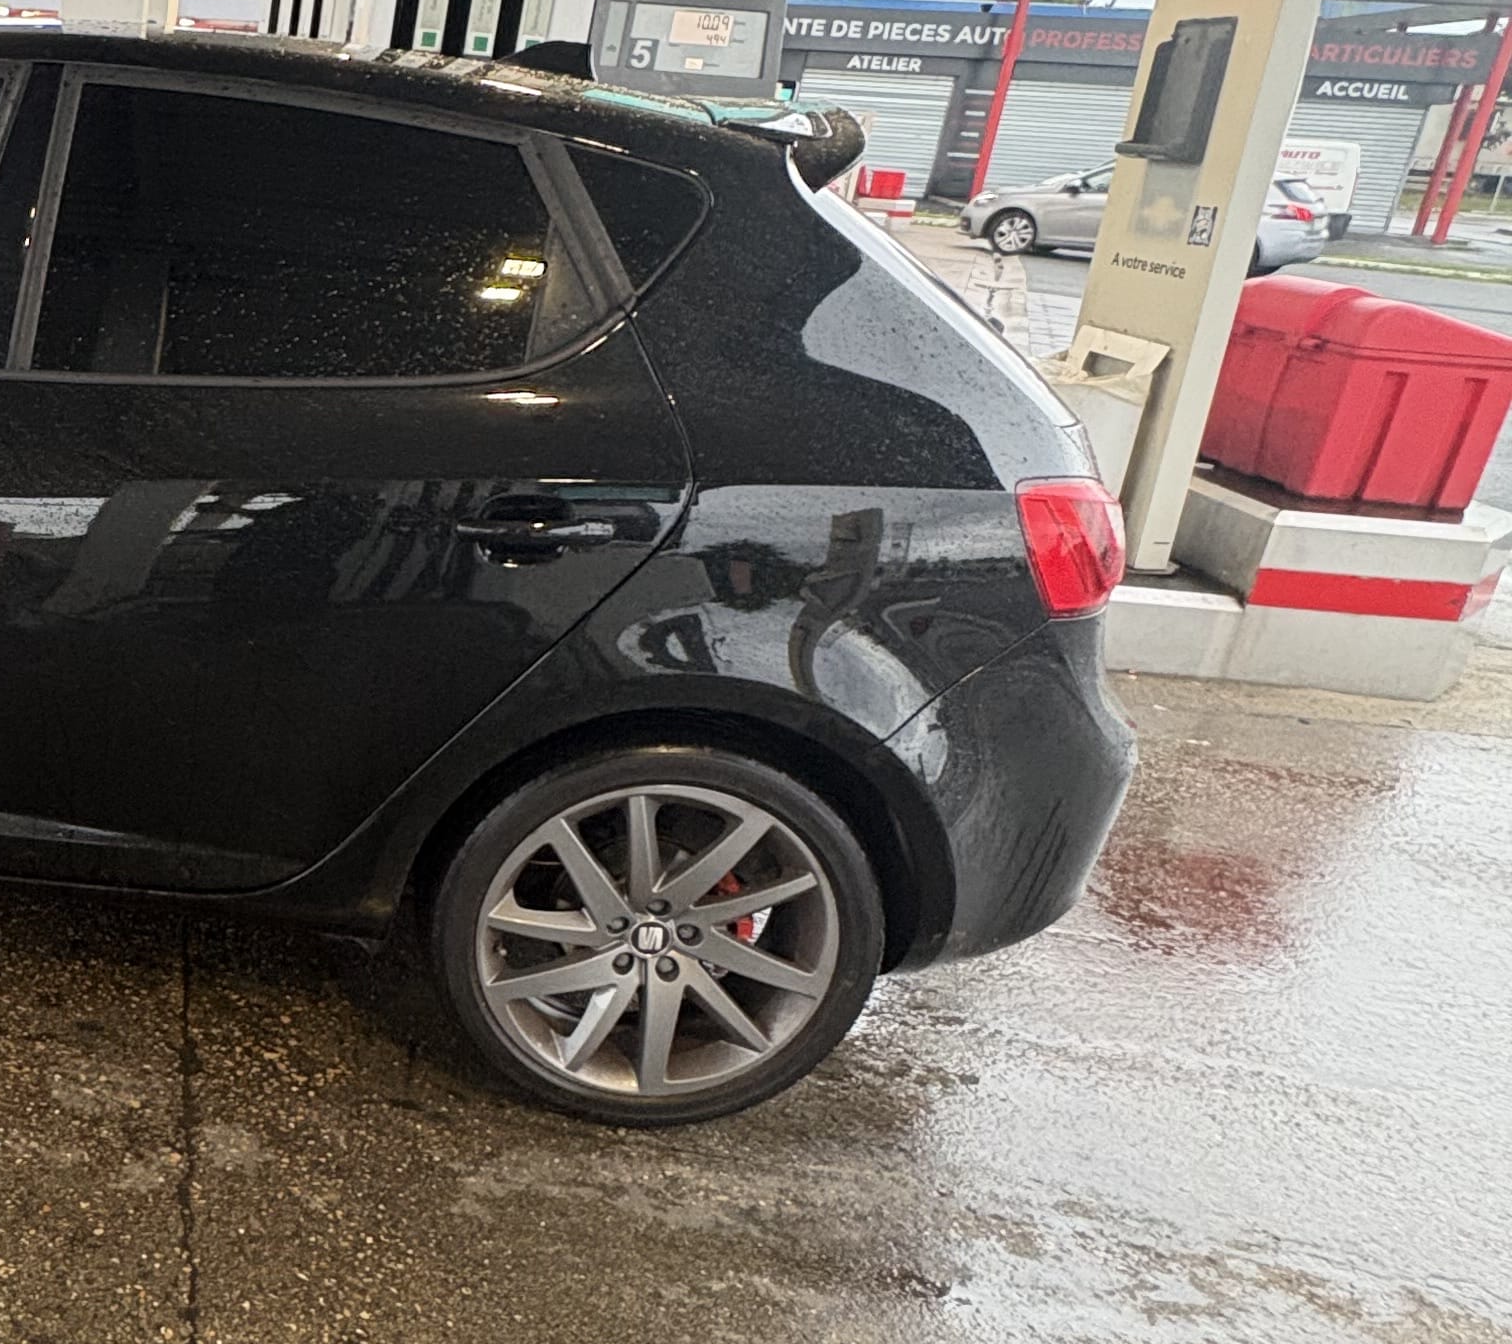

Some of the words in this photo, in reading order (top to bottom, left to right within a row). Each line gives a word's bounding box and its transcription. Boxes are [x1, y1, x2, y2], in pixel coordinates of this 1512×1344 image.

[830, 19, 864, 39] DE
[867, 21, 952, 43] PIECES
[630, 39, 653, 68] 5
[846, 54, 922, 72] ATELIER
[1316, 80, 1409, 101] ACCUEIL
[1121, 256, 1148, 271] votre
[1148, 261, 1186, 280] service
